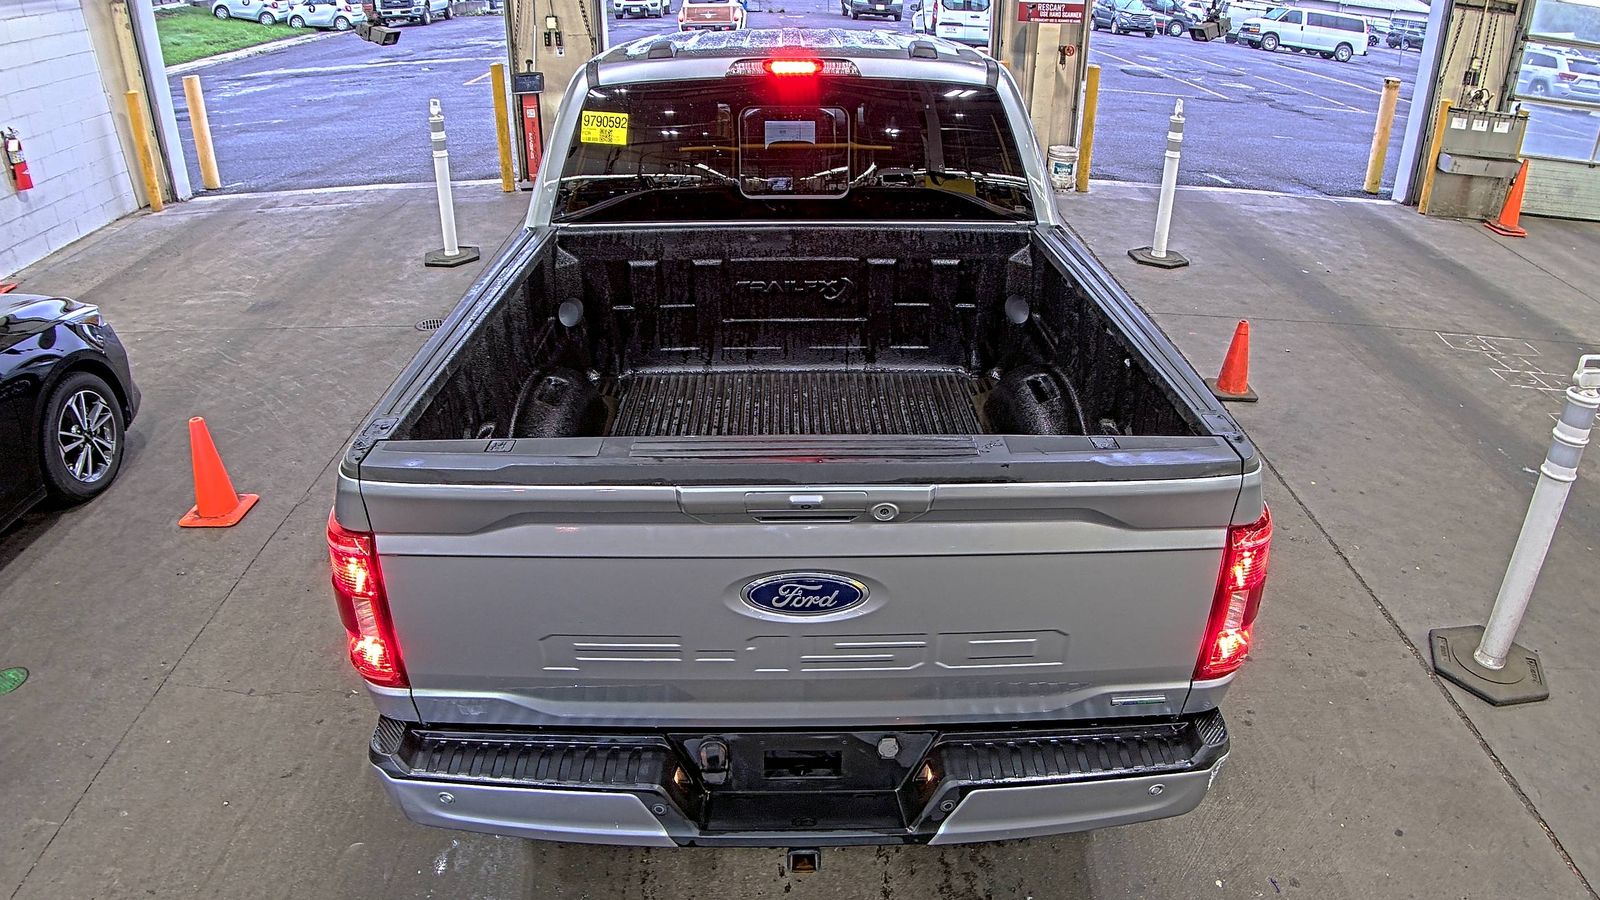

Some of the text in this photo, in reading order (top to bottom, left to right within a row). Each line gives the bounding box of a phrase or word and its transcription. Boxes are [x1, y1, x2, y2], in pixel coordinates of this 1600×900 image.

[1037, 3, 1065, 12] RESCAN?
[583, 114, 627, 128] 9790592
[771, 583, 840, 608] Ford
